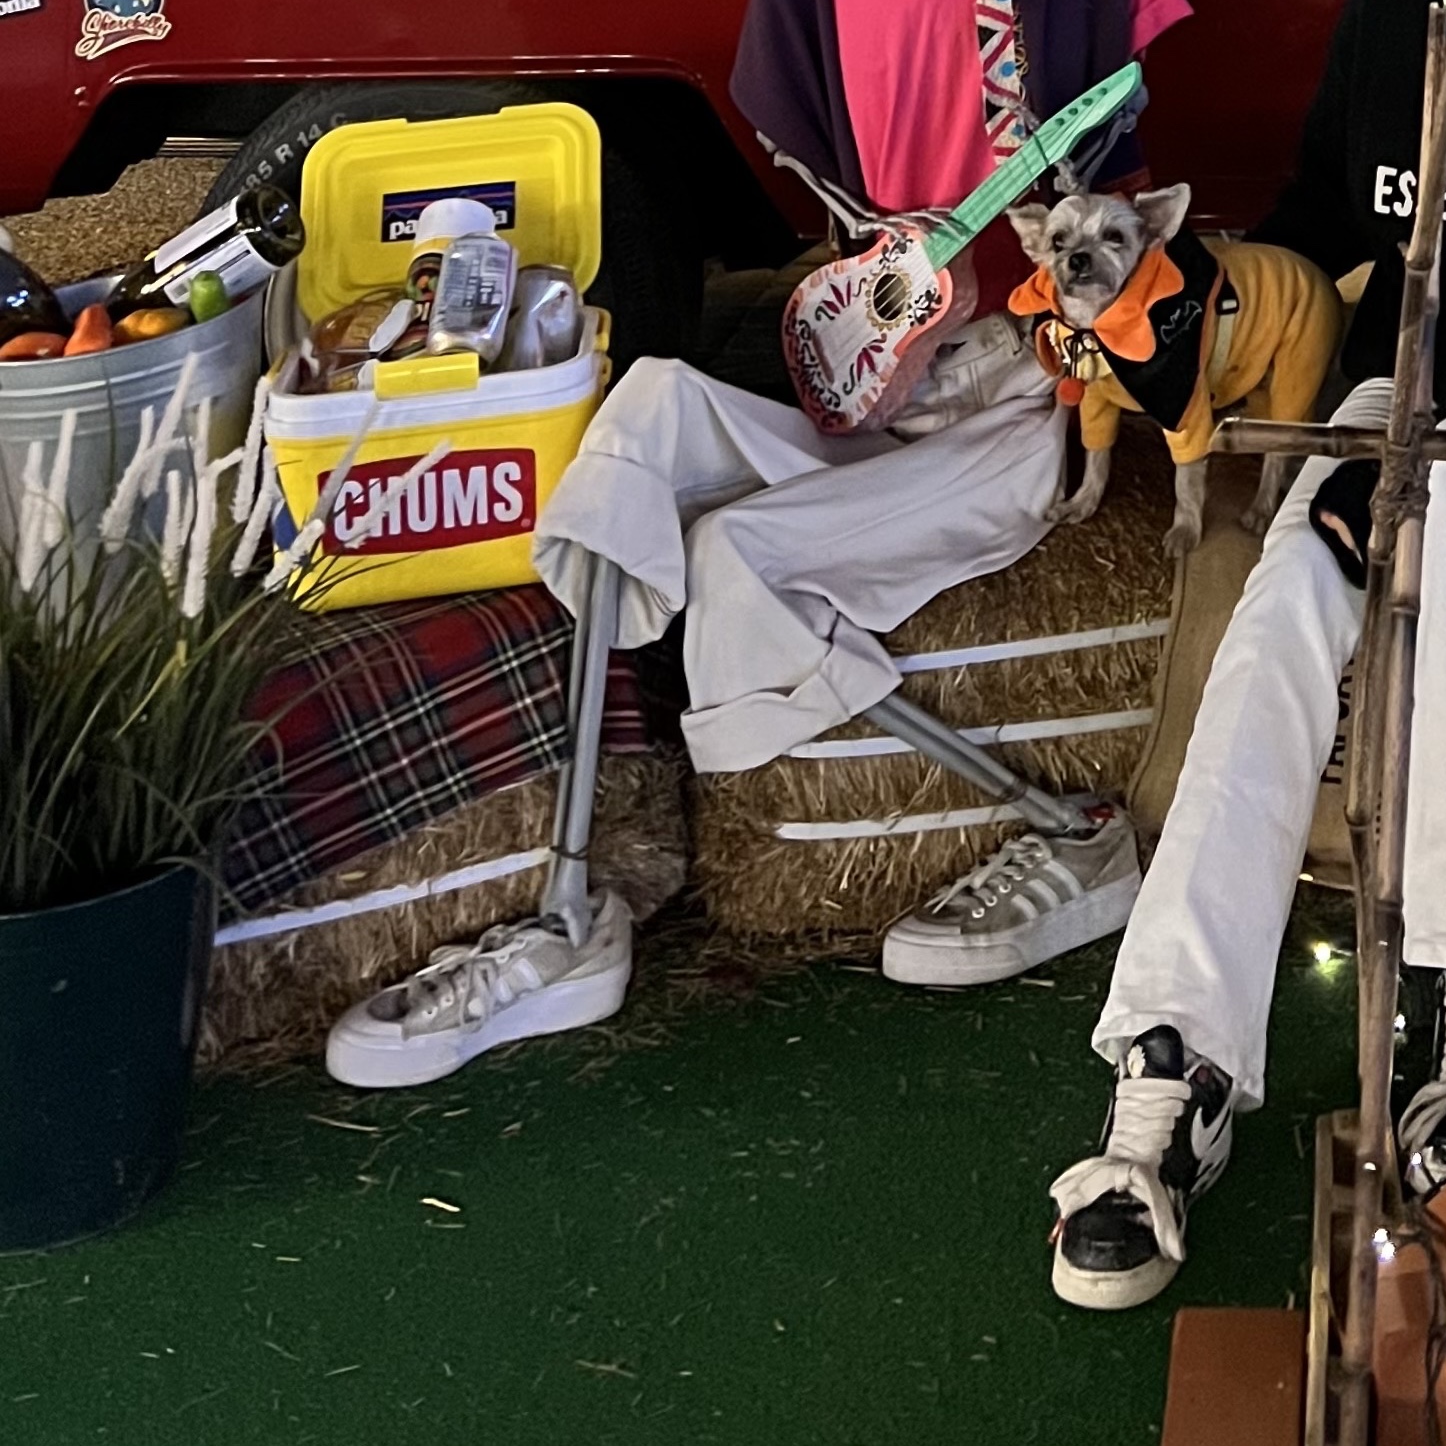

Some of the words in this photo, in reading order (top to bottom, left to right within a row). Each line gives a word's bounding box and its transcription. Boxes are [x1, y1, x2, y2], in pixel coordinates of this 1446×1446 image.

[274, 143, 294, 164] R
[297, 123, 323, 148] 14
[332, 460, 525, 545] CHUMS
